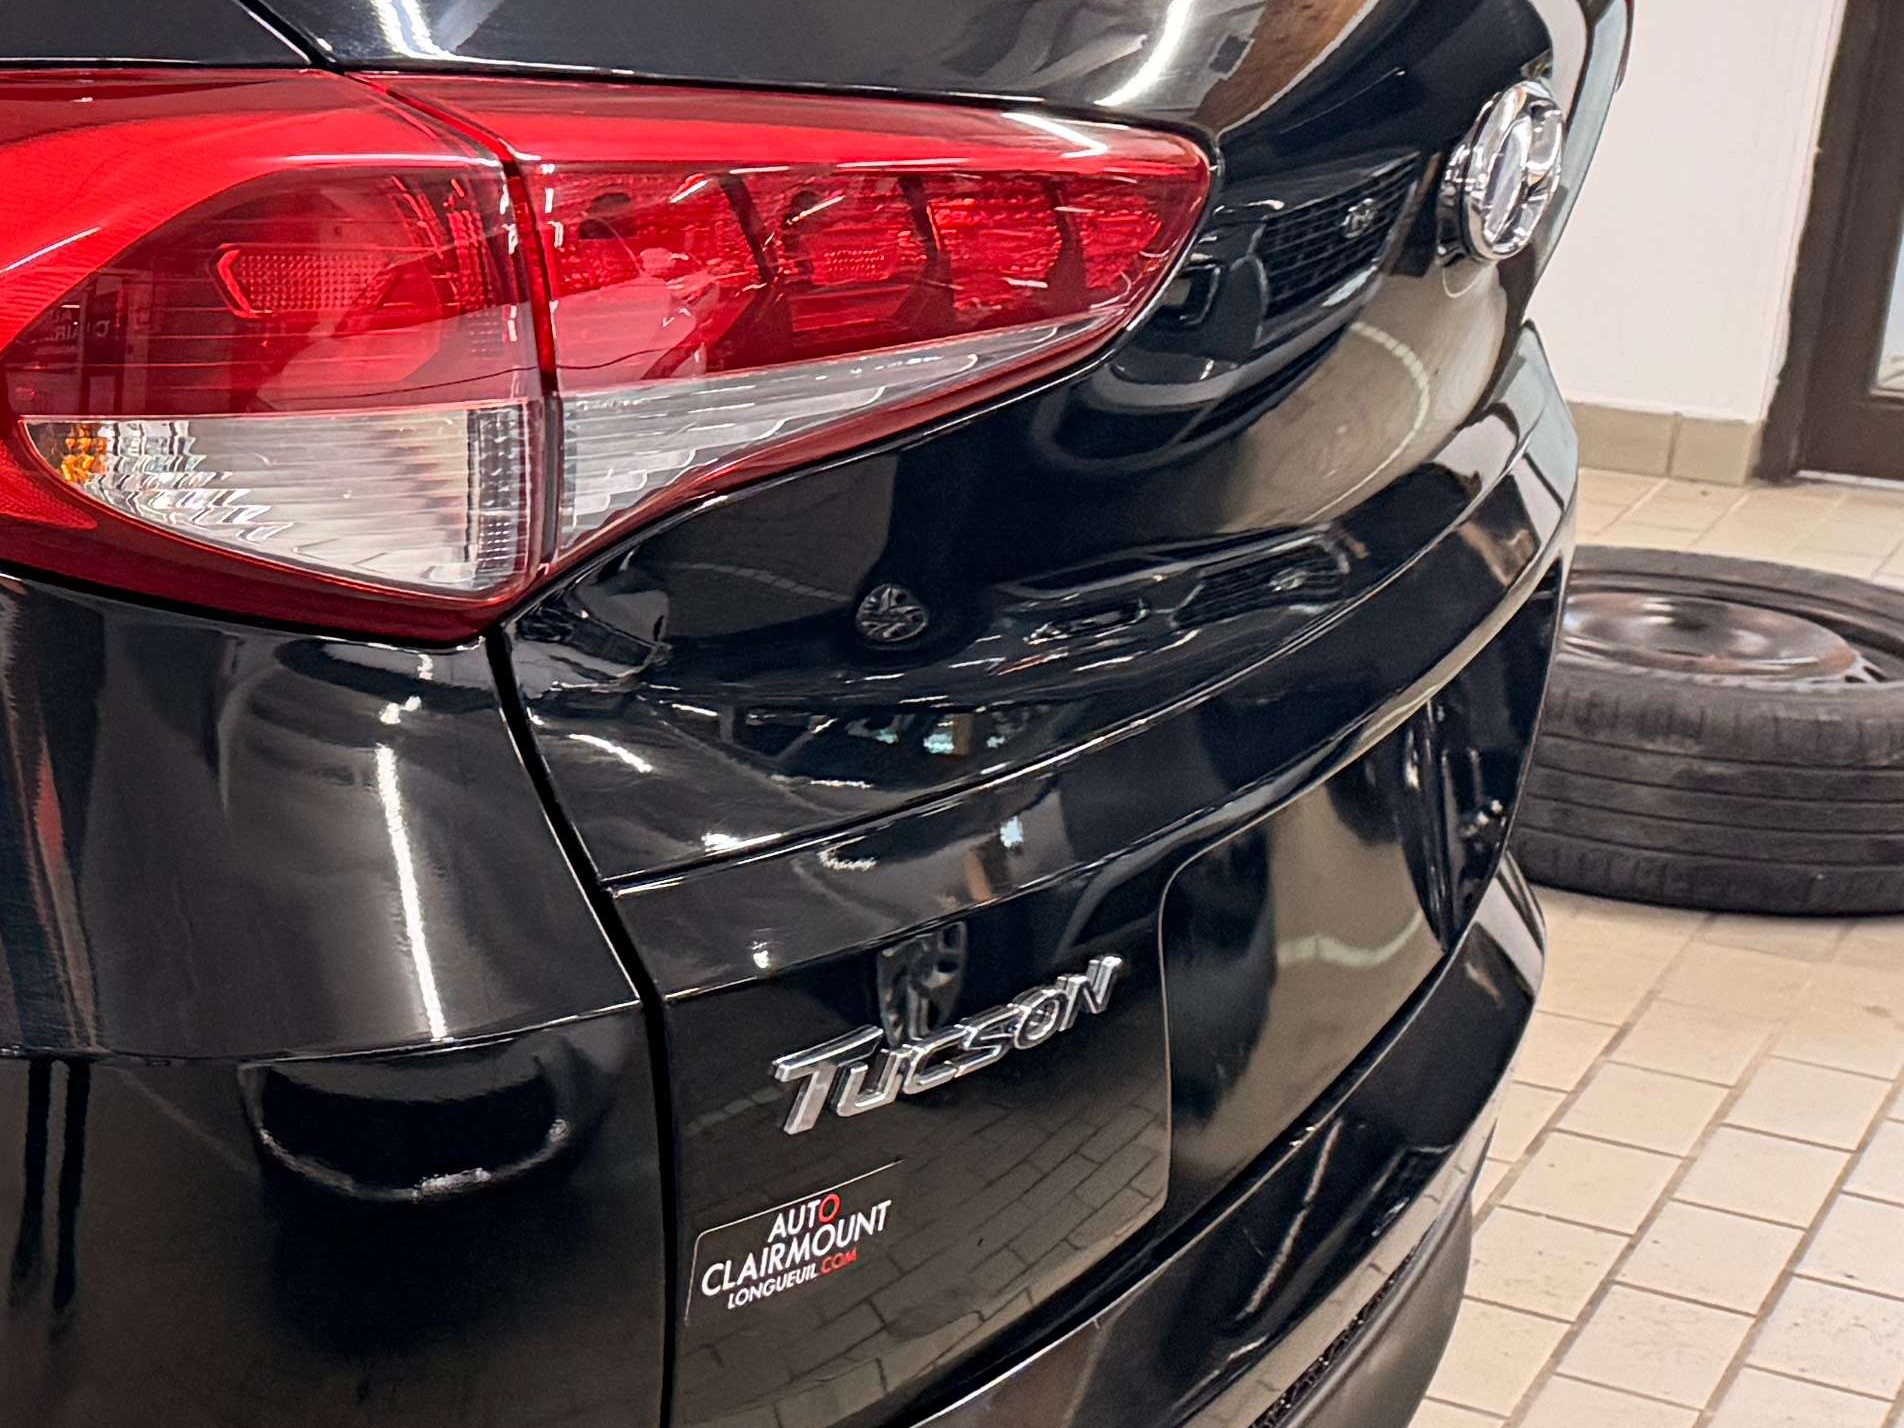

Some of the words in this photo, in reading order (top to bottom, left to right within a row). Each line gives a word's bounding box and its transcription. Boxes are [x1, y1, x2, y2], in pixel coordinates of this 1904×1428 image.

[769, 954, 1124, 1135] TUCSON
[701, 1199, 893, 1297] CLAIRMOUNT
[767, 1193, 842, 1243] AUTO
